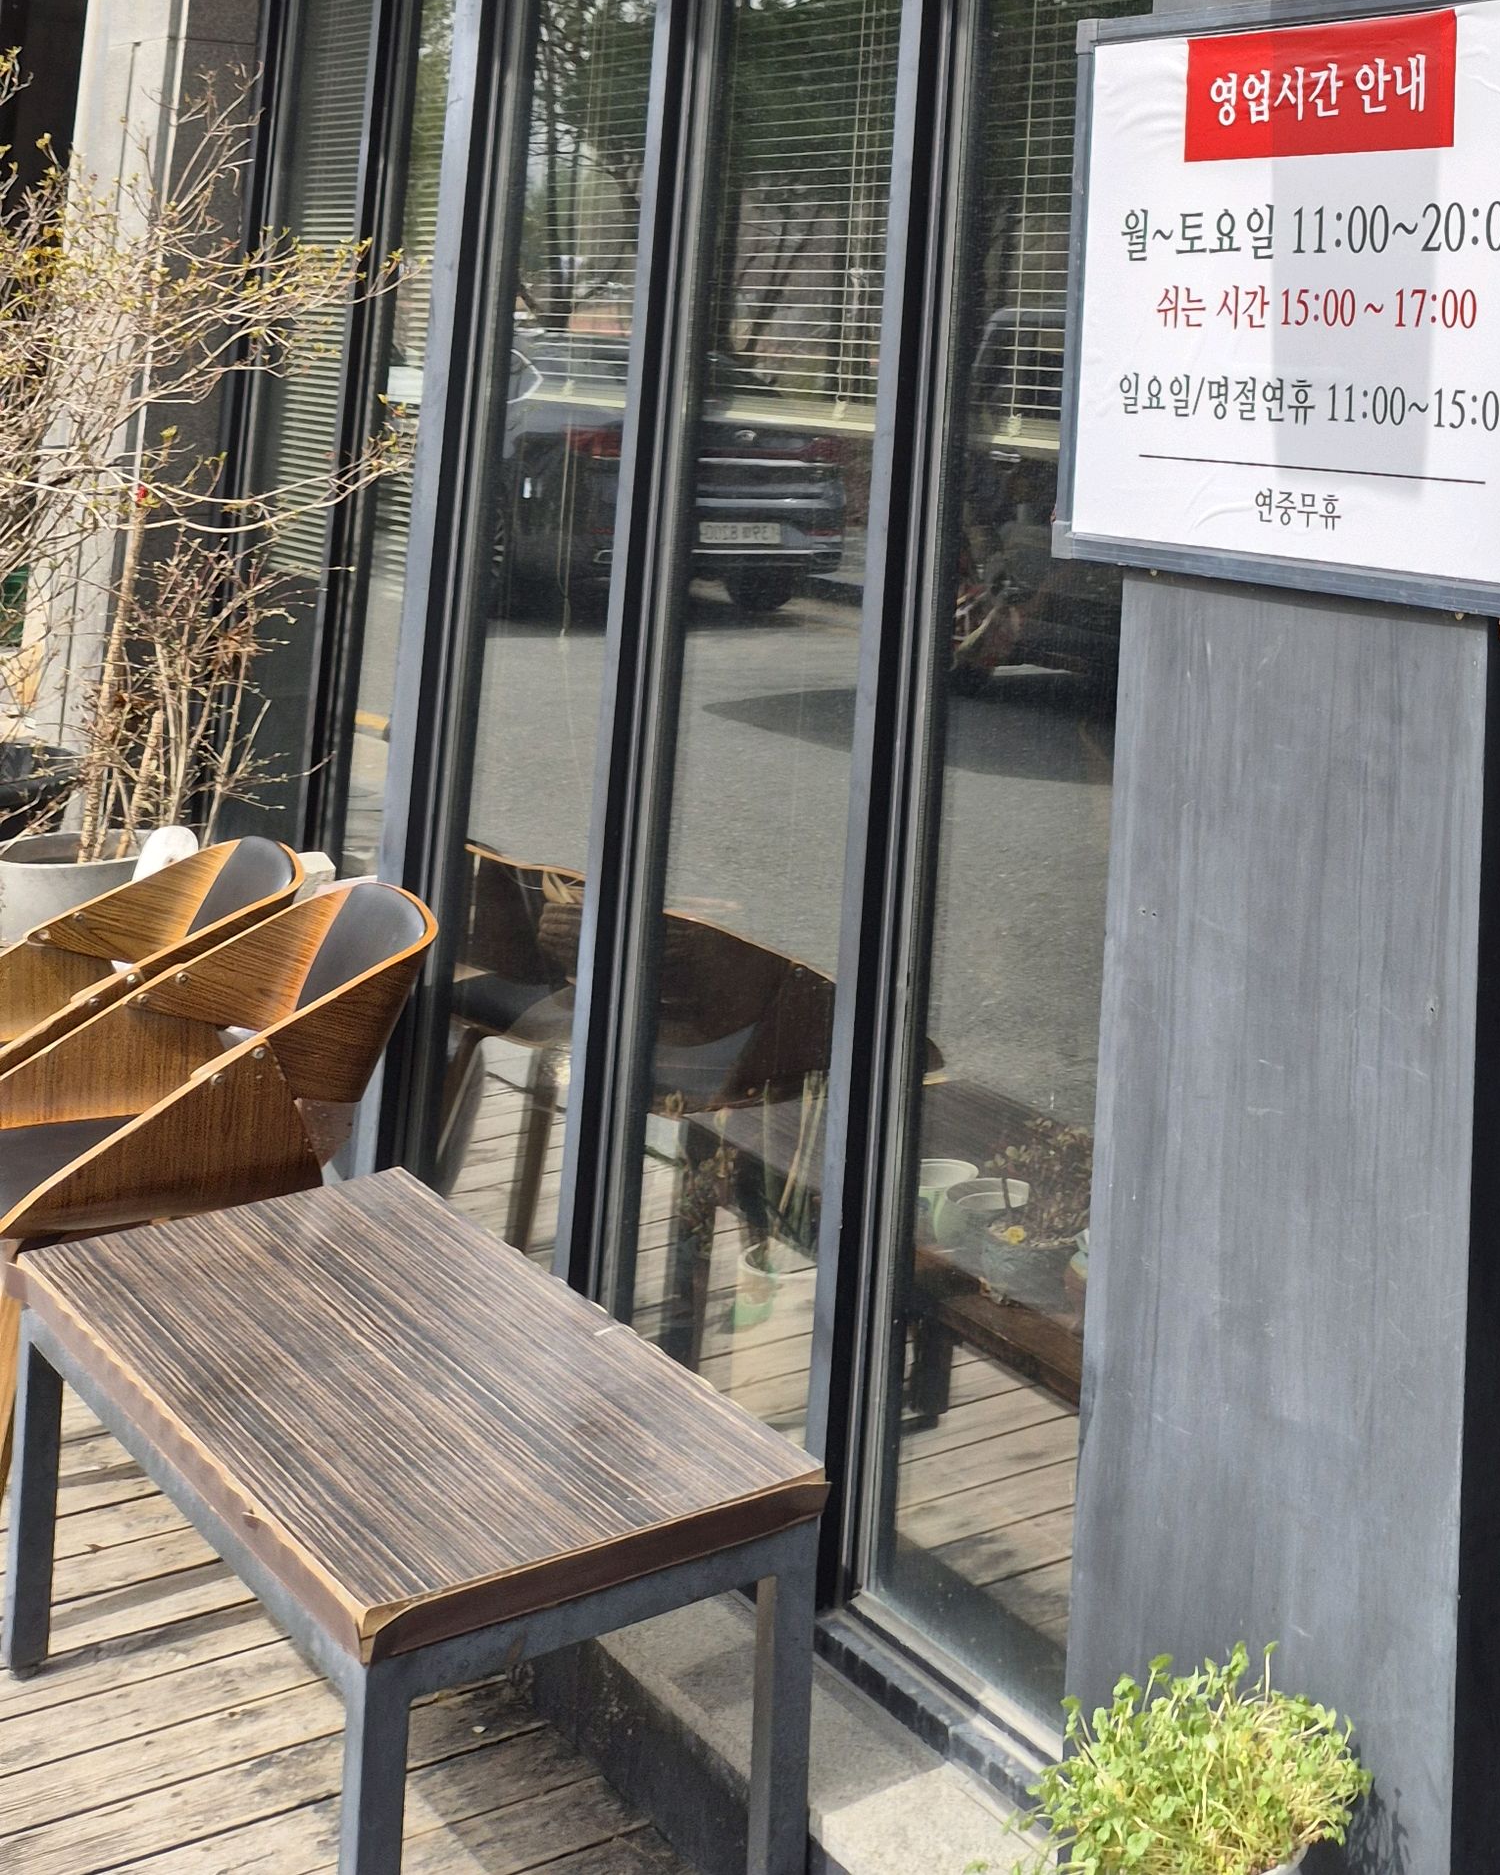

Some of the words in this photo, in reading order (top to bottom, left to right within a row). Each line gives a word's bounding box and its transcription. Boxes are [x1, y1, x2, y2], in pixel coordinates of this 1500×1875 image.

[1209, 61, 1344, 127] 영업시간
[1355, 53, 1427, 116] 안내
[1121, 202, 1276, 264] 월~토요일
[1156, 284, 1207, 330] 쉬는
[1216, 284, 1271, 331] 시간
[1118, 371, 1316, 429] 일요일/명절연휴
[1254, 489, 1342, 531] 연중무휴
